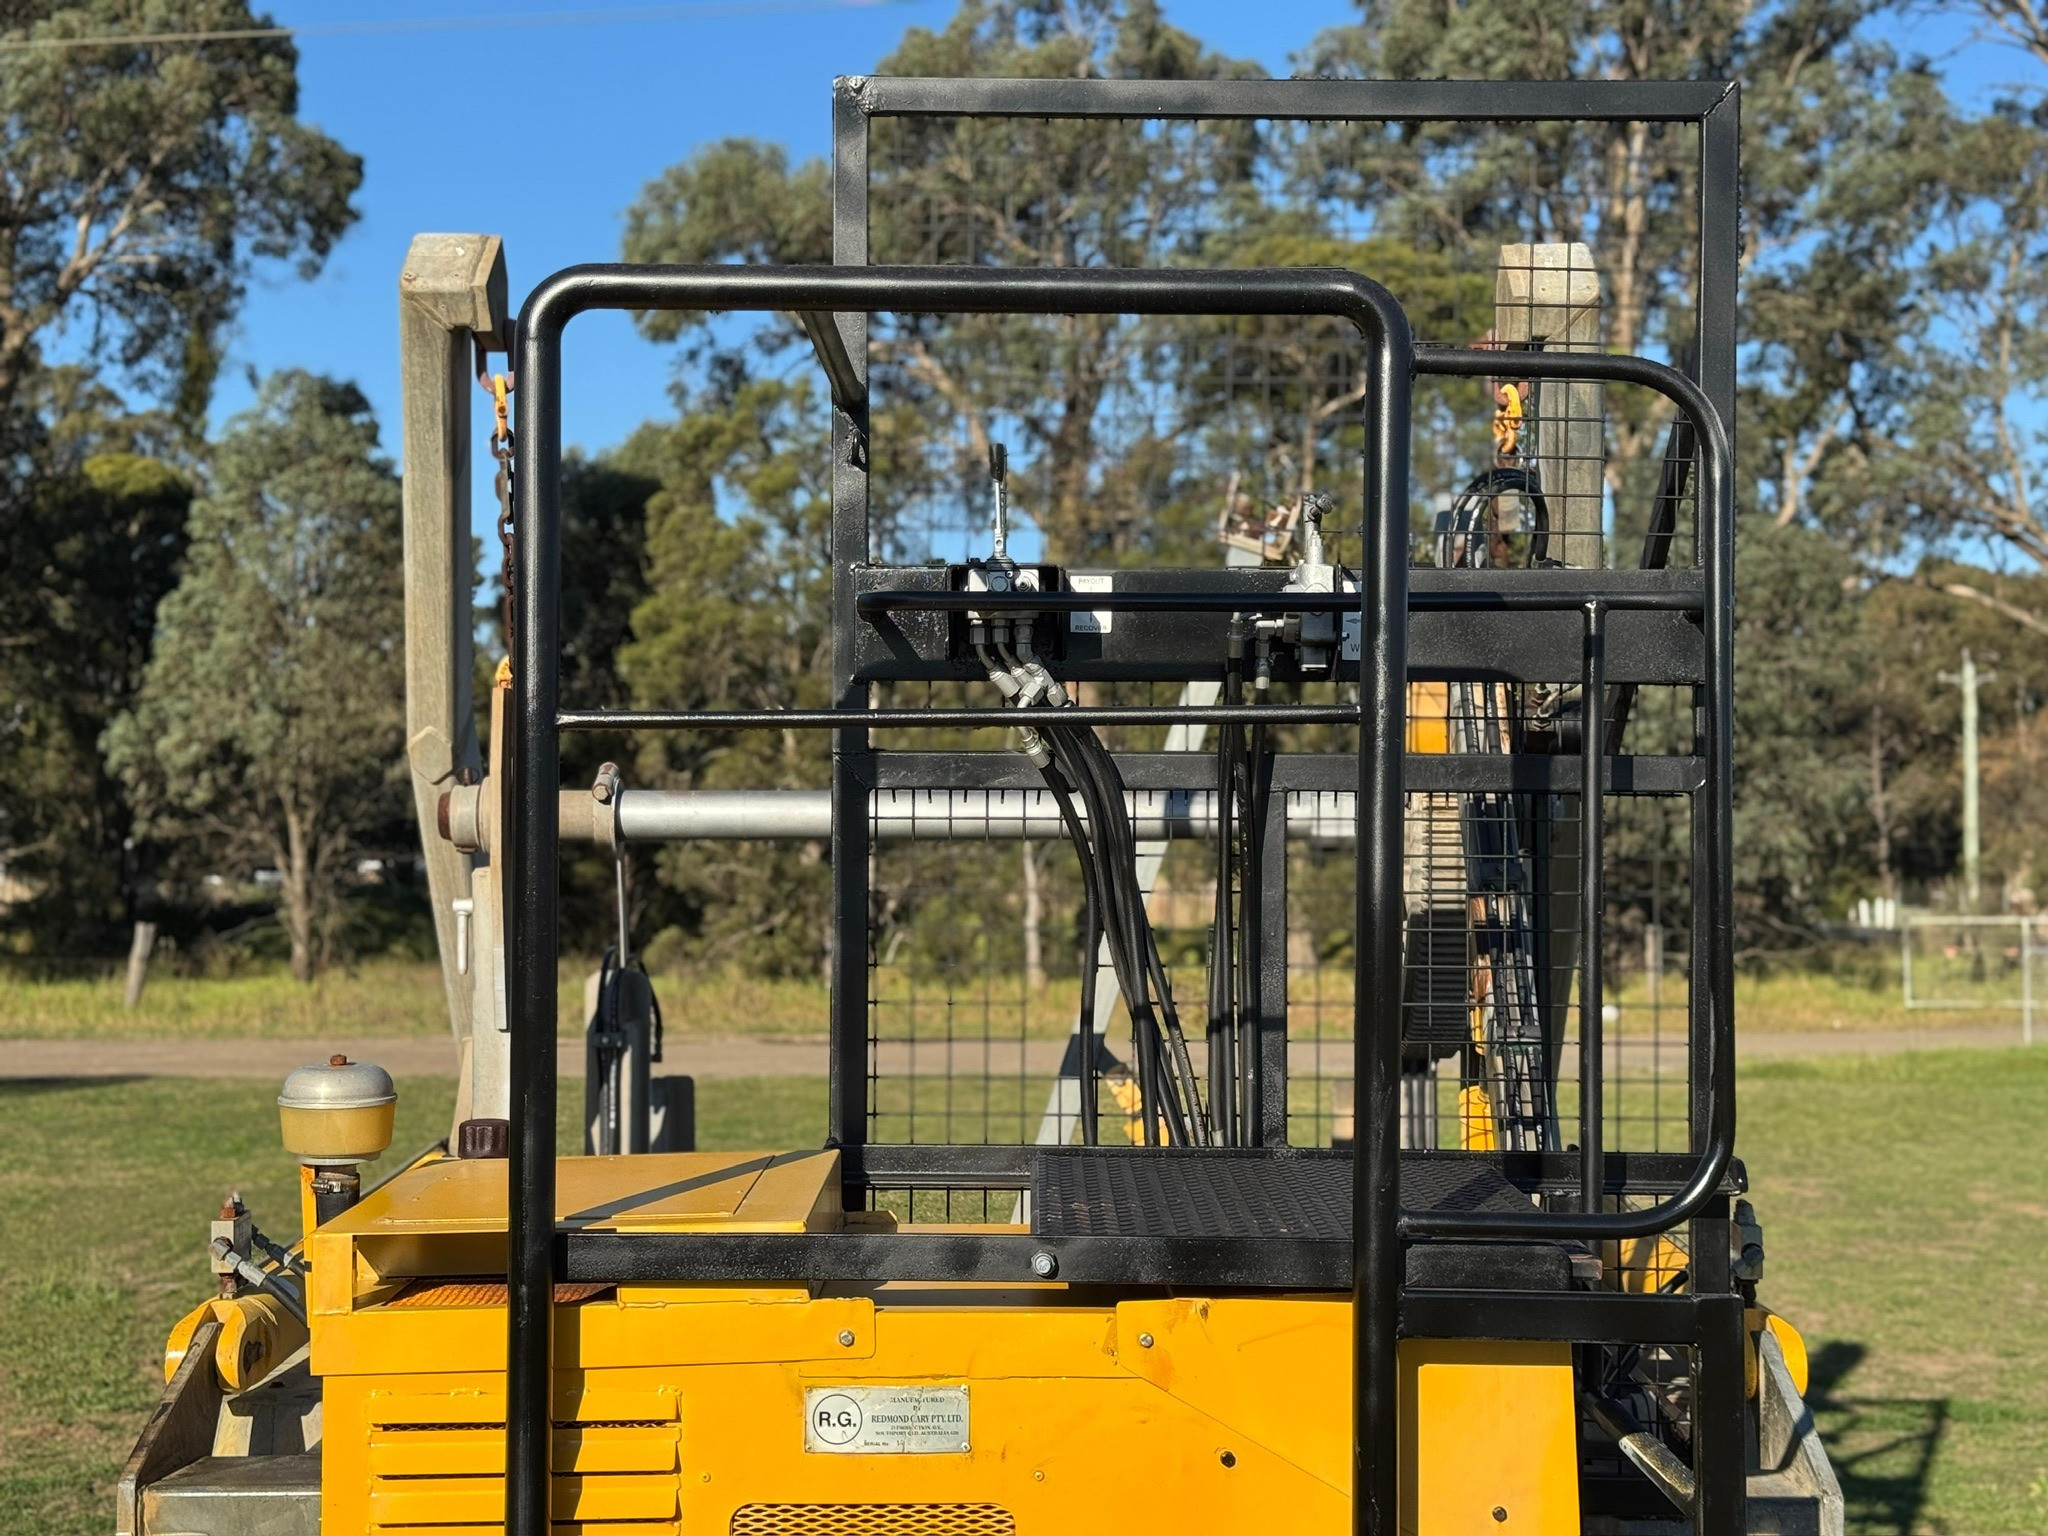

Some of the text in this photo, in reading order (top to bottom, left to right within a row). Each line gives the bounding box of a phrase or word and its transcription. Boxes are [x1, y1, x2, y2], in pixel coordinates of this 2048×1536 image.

[818, 1411, 857, 1428] R.G.
[871, 1414, 909, 1423] REDMOND
[910, 1414, 930, 1423] CARY
[947, 1414, 963, 1423] LTD.
